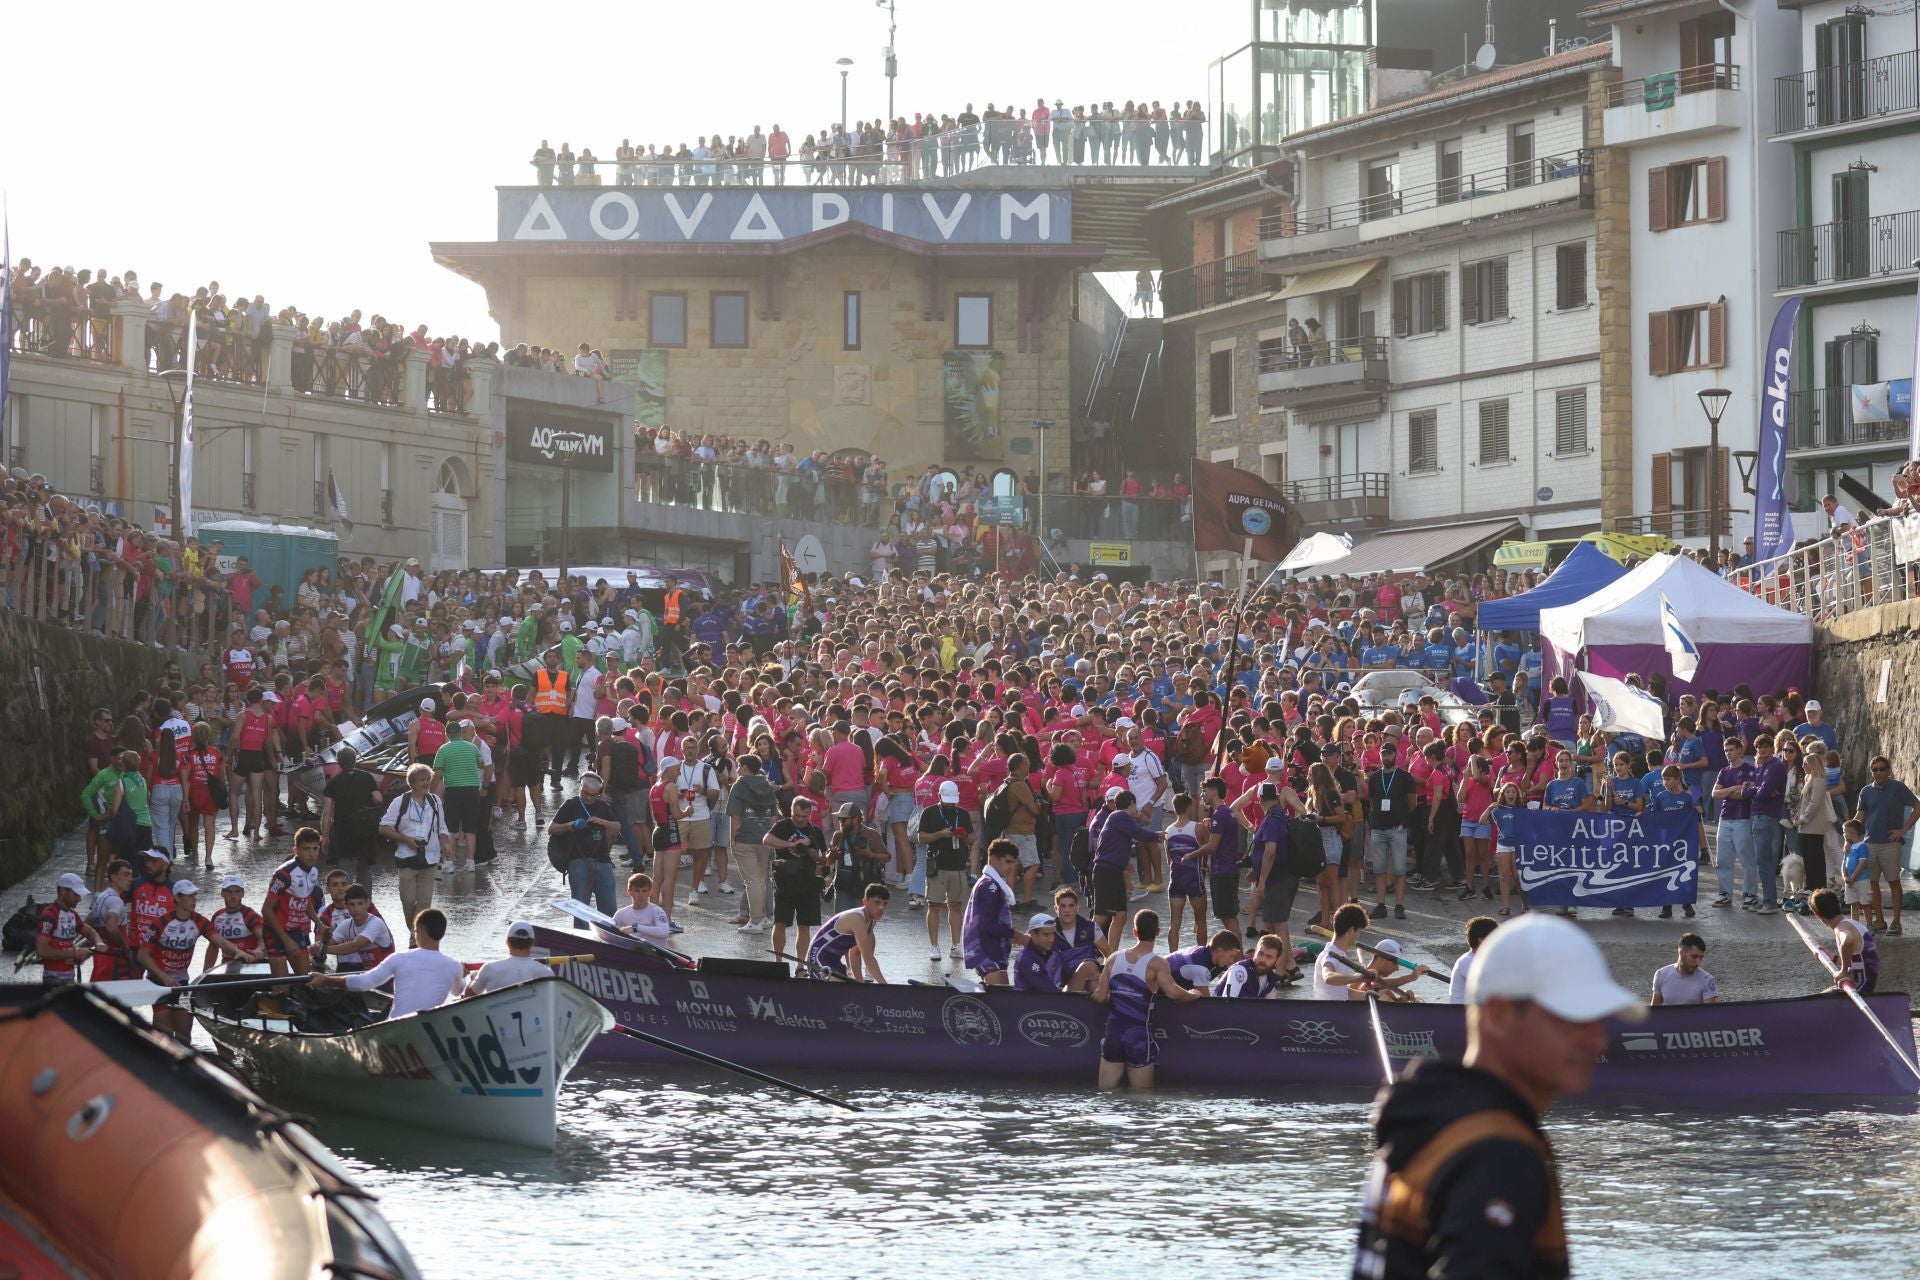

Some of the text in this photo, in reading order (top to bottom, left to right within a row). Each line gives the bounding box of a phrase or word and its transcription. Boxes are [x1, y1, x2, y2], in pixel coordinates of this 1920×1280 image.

[1228, 494, 1285, 514] AUPA GETARIA
[1571, 818, 1645, 839] AUPA
[135, 900, 168, 917] kide
[676, 1001, 737, 1019] MOYUA
[775, 1003, 828, 1031] elektra
[876, 1005, 926, 1020] Pasaiako
[1026, 1016, 1079, 1031] amara
[1030, 1028, 1083, 1042] graphic
[1662, 1028, 1766, 1050] ZUBIEDER
[1627, 1049, 1772, 1061] CONSTRUCCIONES
